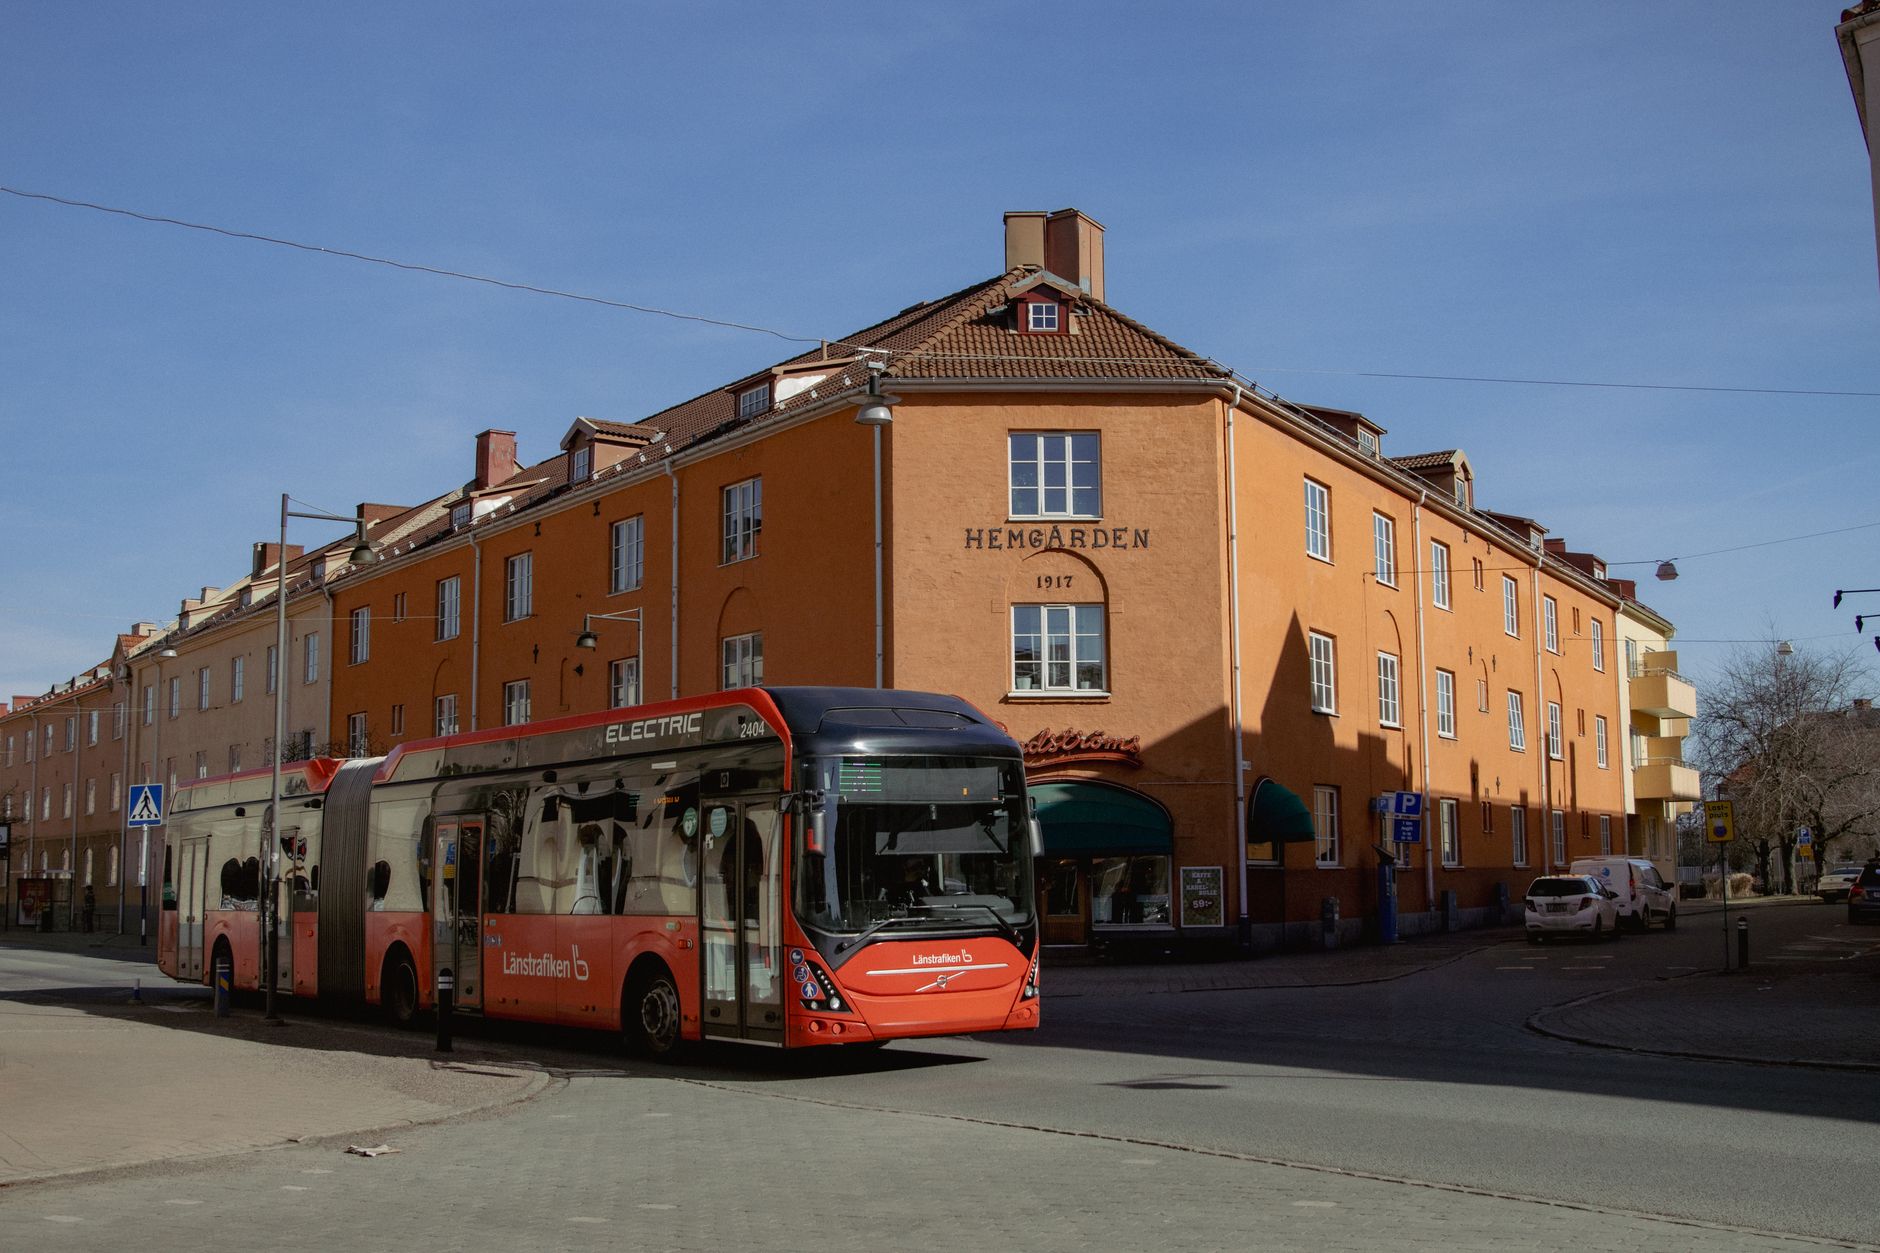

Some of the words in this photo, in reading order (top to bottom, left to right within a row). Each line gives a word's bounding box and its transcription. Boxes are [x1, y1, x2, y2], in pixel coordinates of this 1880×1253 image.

[964, 525, 1150, 549] HEMGÅRDEN
[1036, 575, 1073, 588] 1917
[606, 713, 702, 743] ELECTRIC
[740, 721, 765, 738] 2404
[1402, 794, 1416, 812] P
[503, 951, 571, 978] Länstrafiken
[913, 953, 961, 964] Länstrafiken
